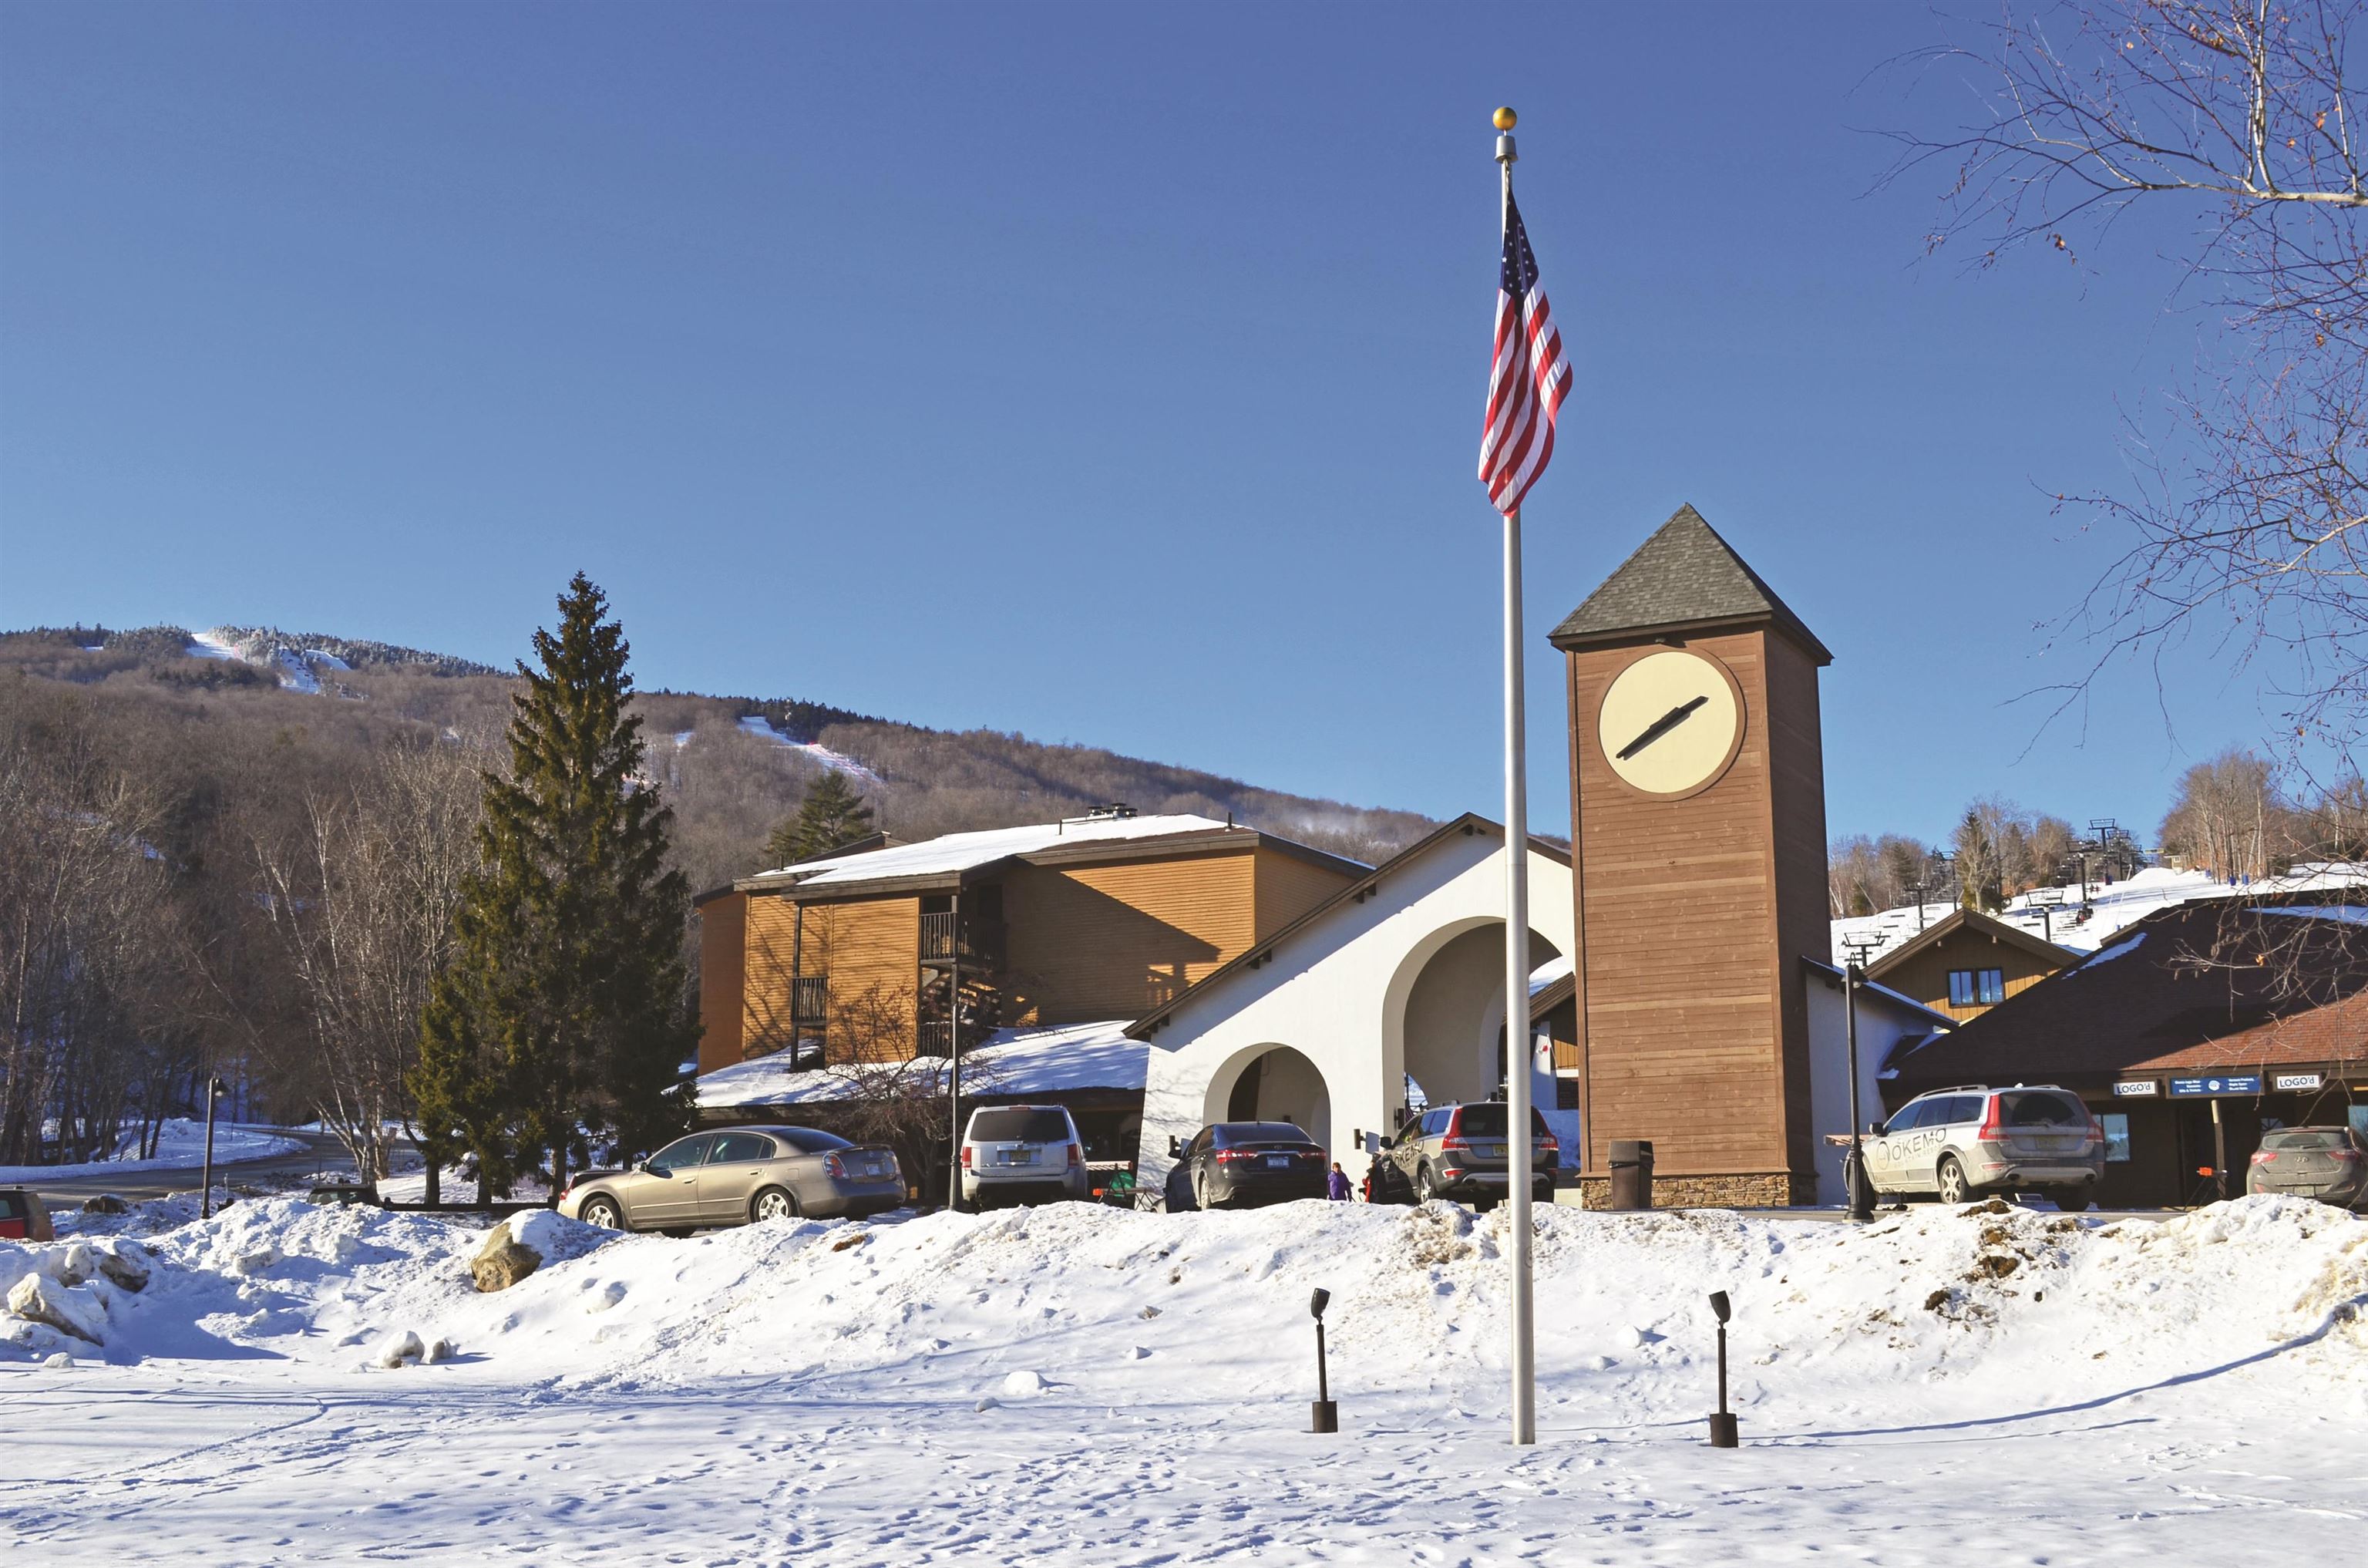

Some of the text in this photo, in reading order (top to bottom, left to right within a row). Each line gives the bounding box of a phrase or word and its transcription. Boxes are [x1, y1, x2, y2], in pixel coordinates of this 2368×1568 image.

[2279, 1076, 2315, 1088] LOGO'd
[2117, 1083, 2151, 1094] LOGO'd
[1892, 1128, 1946, 1161] OKEMO
